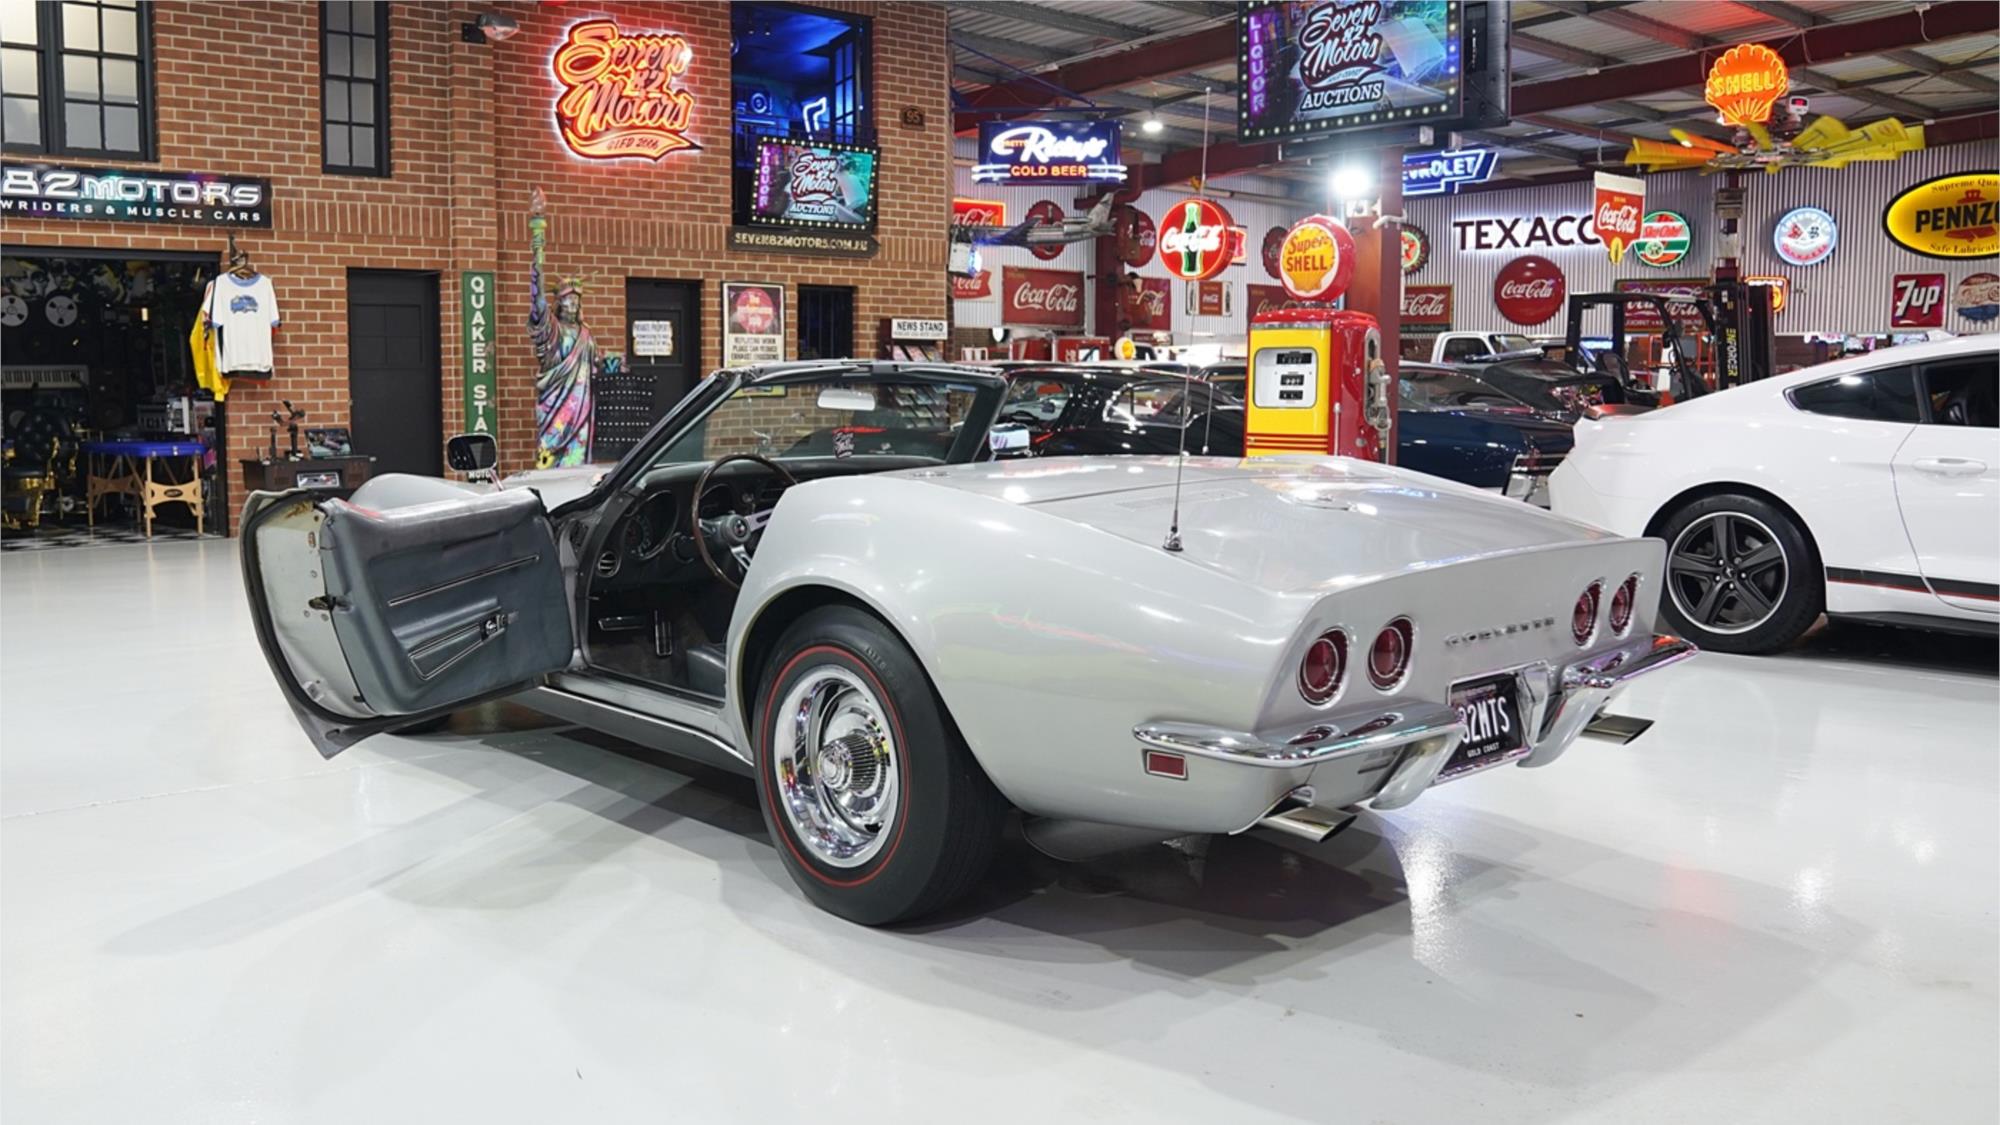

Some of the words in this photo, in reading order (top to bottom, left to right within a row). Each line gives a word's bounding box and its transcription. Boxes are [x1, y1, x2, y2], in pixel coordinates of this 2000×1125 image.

[1302, 3, 1377, 47] Seven
[560, 22, 690, 85] Seven
[1250, 16, 1265, 112] LIQUOR
[1302, 38, 1379, 77] Motors
[1302, 83, 1381, 109] AUCTIONS
[1714, 71, 1775, 97] SHELL
[564, 80, 692, 136] Motors
[759, 146, 770, 209] LIQUOR
[1011, 165, 1048, 177] COLD
[1051, 165, 1087, 178] BEER
[105, 205, 115, 214] &
[127, 206, 203, 219] MUSCLE
[214, 211, 260, 221] CARS
[789, 203, 835, 215] AUCTIONS
[1916, 201, 1999, 233] PENNZ
[1287, 255, 1328, 272] SHELL
[470, 276, 486, 374] QUAKER
[897, 322, 917, 331] NEWS
[920, 322, 944, 333] STAND
[1726, 328, 1738, 377] ENFORCER
